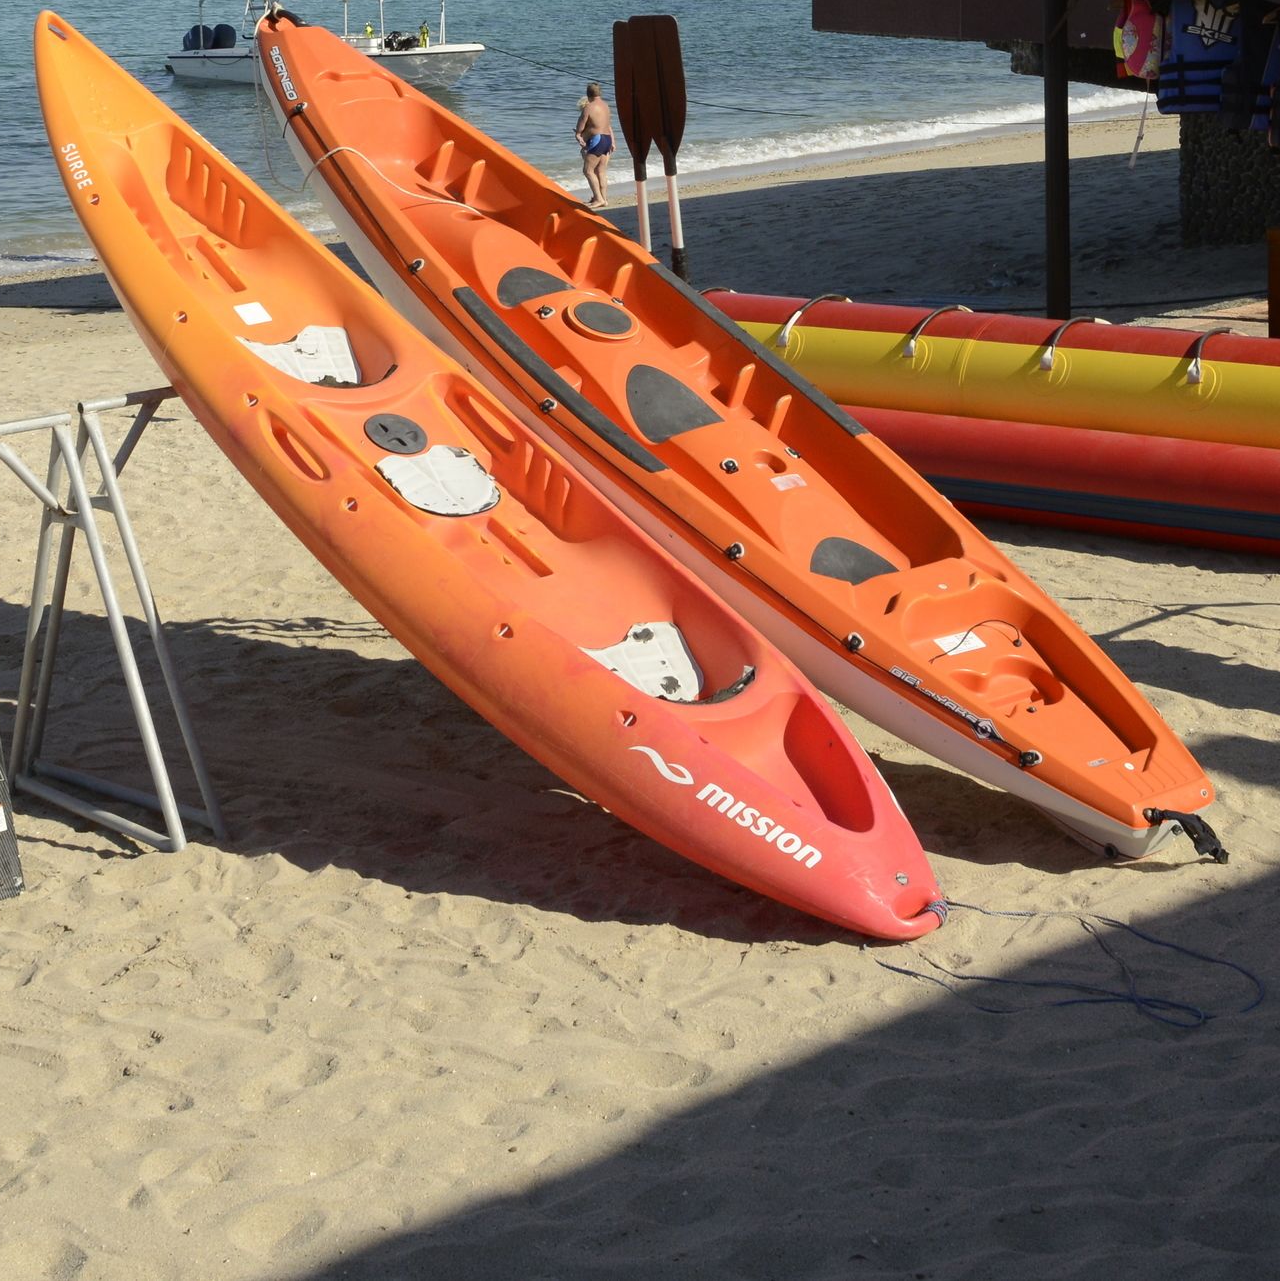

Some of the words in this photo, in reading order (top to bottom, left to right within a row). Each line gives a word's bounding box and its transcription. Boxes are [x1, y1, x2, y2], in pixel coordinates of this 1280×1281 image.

[1186, 25, 1233, 43] SKIS
[61, 143, 93, 190] SURGE
[696, 782, 822, 869] mission
